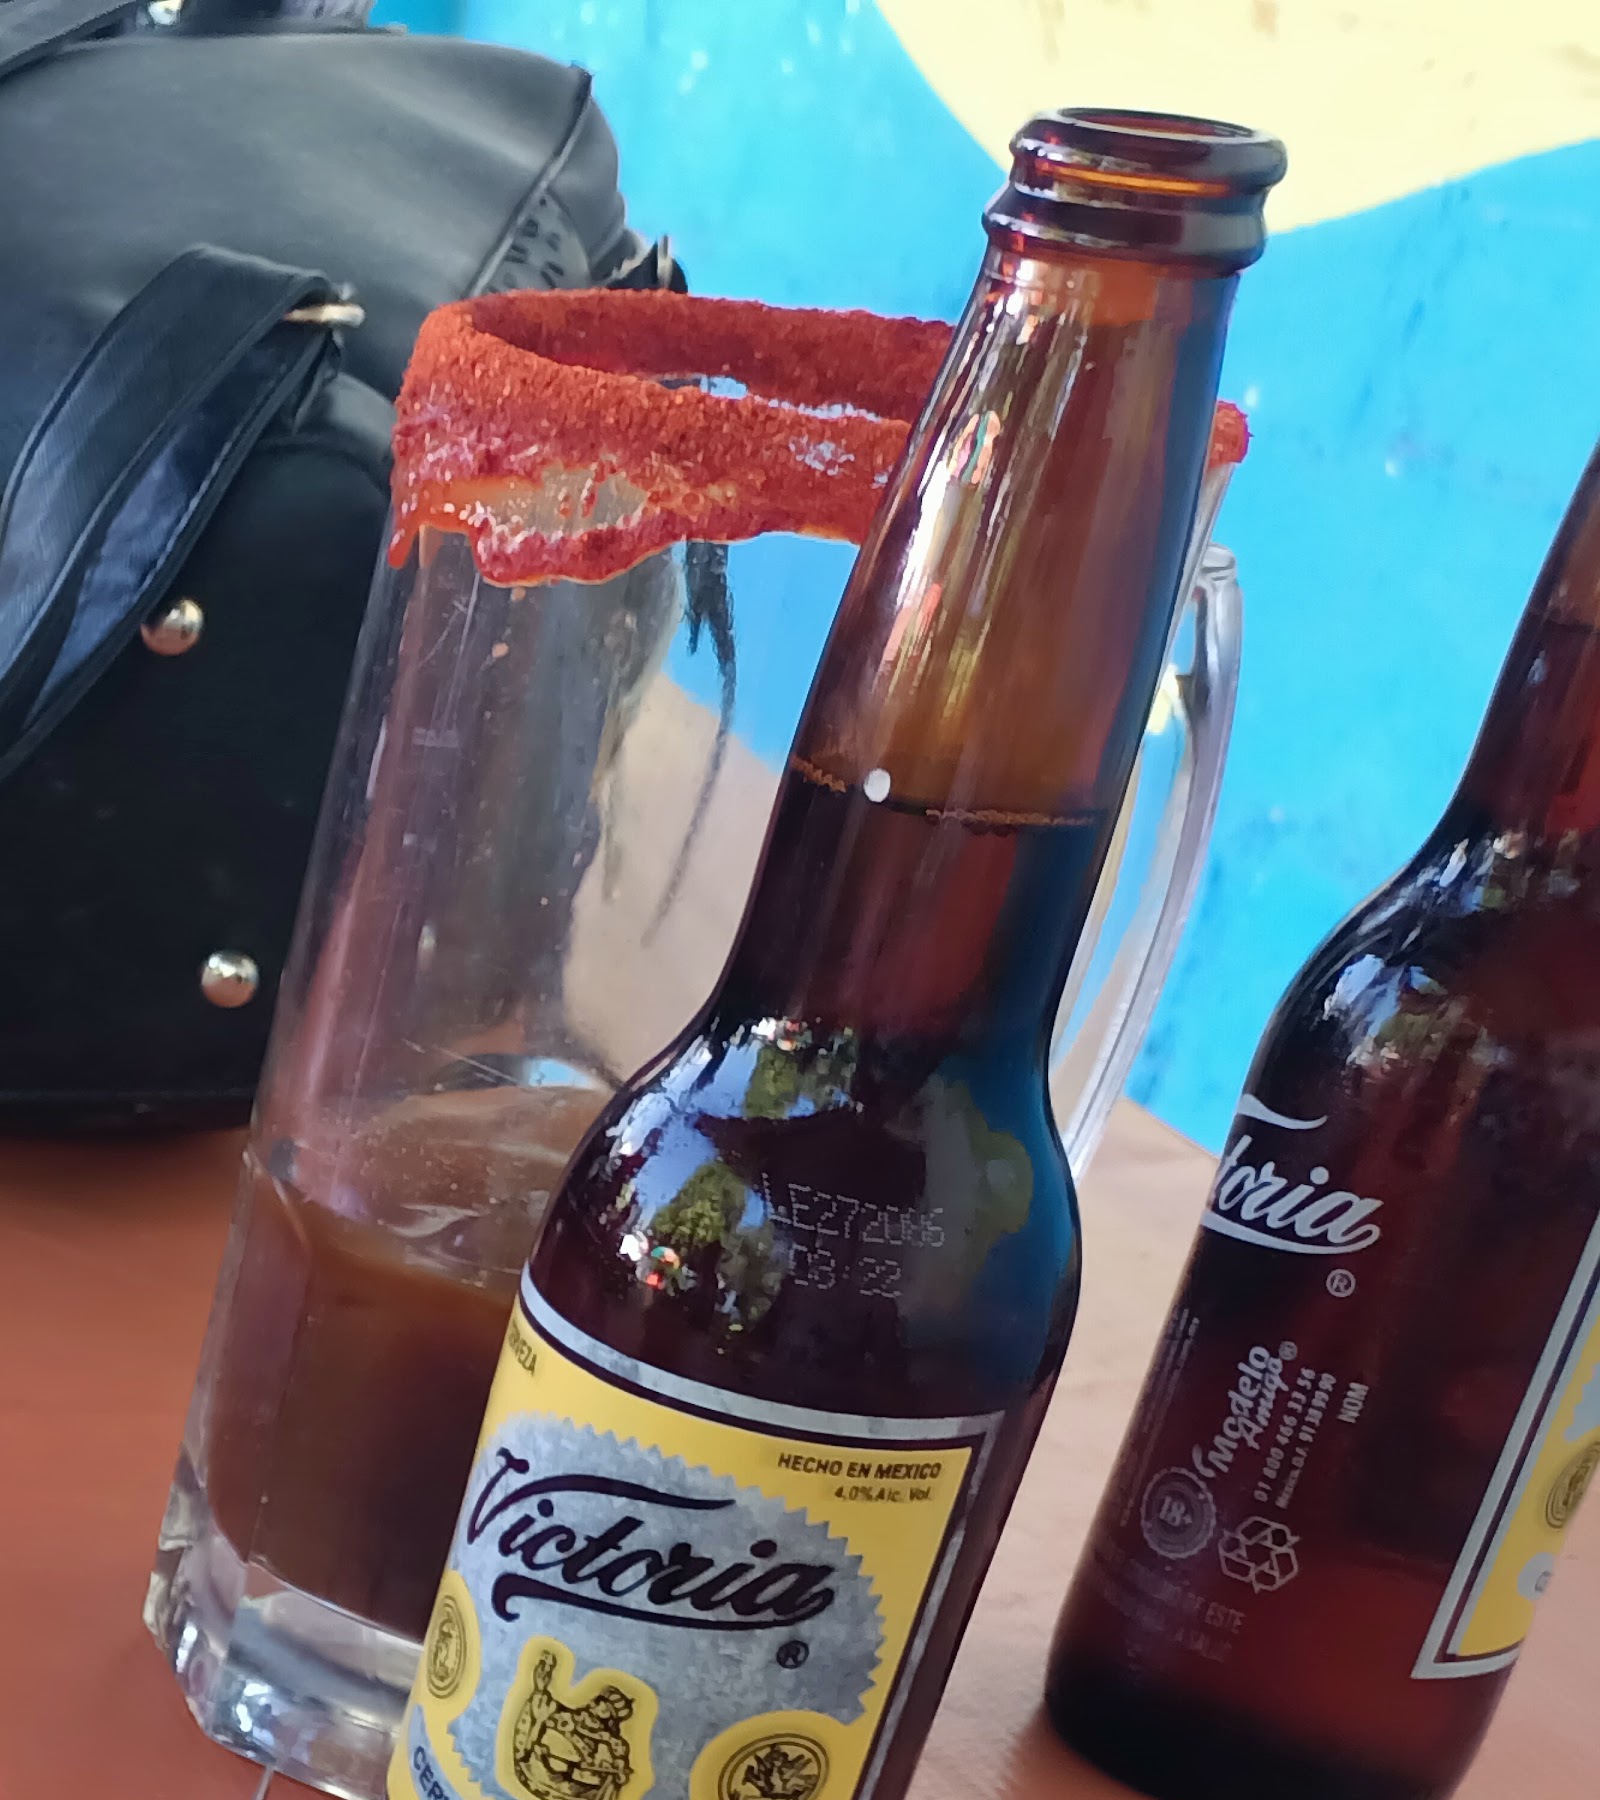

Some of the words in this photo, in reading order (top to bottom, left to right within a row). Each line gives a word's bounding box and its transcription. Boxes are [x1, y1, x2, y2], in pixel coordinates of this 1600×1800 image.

[1206, 1345, 1270, 1474] Modelo
[1236, 1357, 1289, 1450] Amigo
[777, 1452, 843, 1477] HECHO
[846, 1462, 872, 1479] EN
[873, 1462, 942, 1480] MEXICO
[468, 1447, 836, 1630] Victoria
